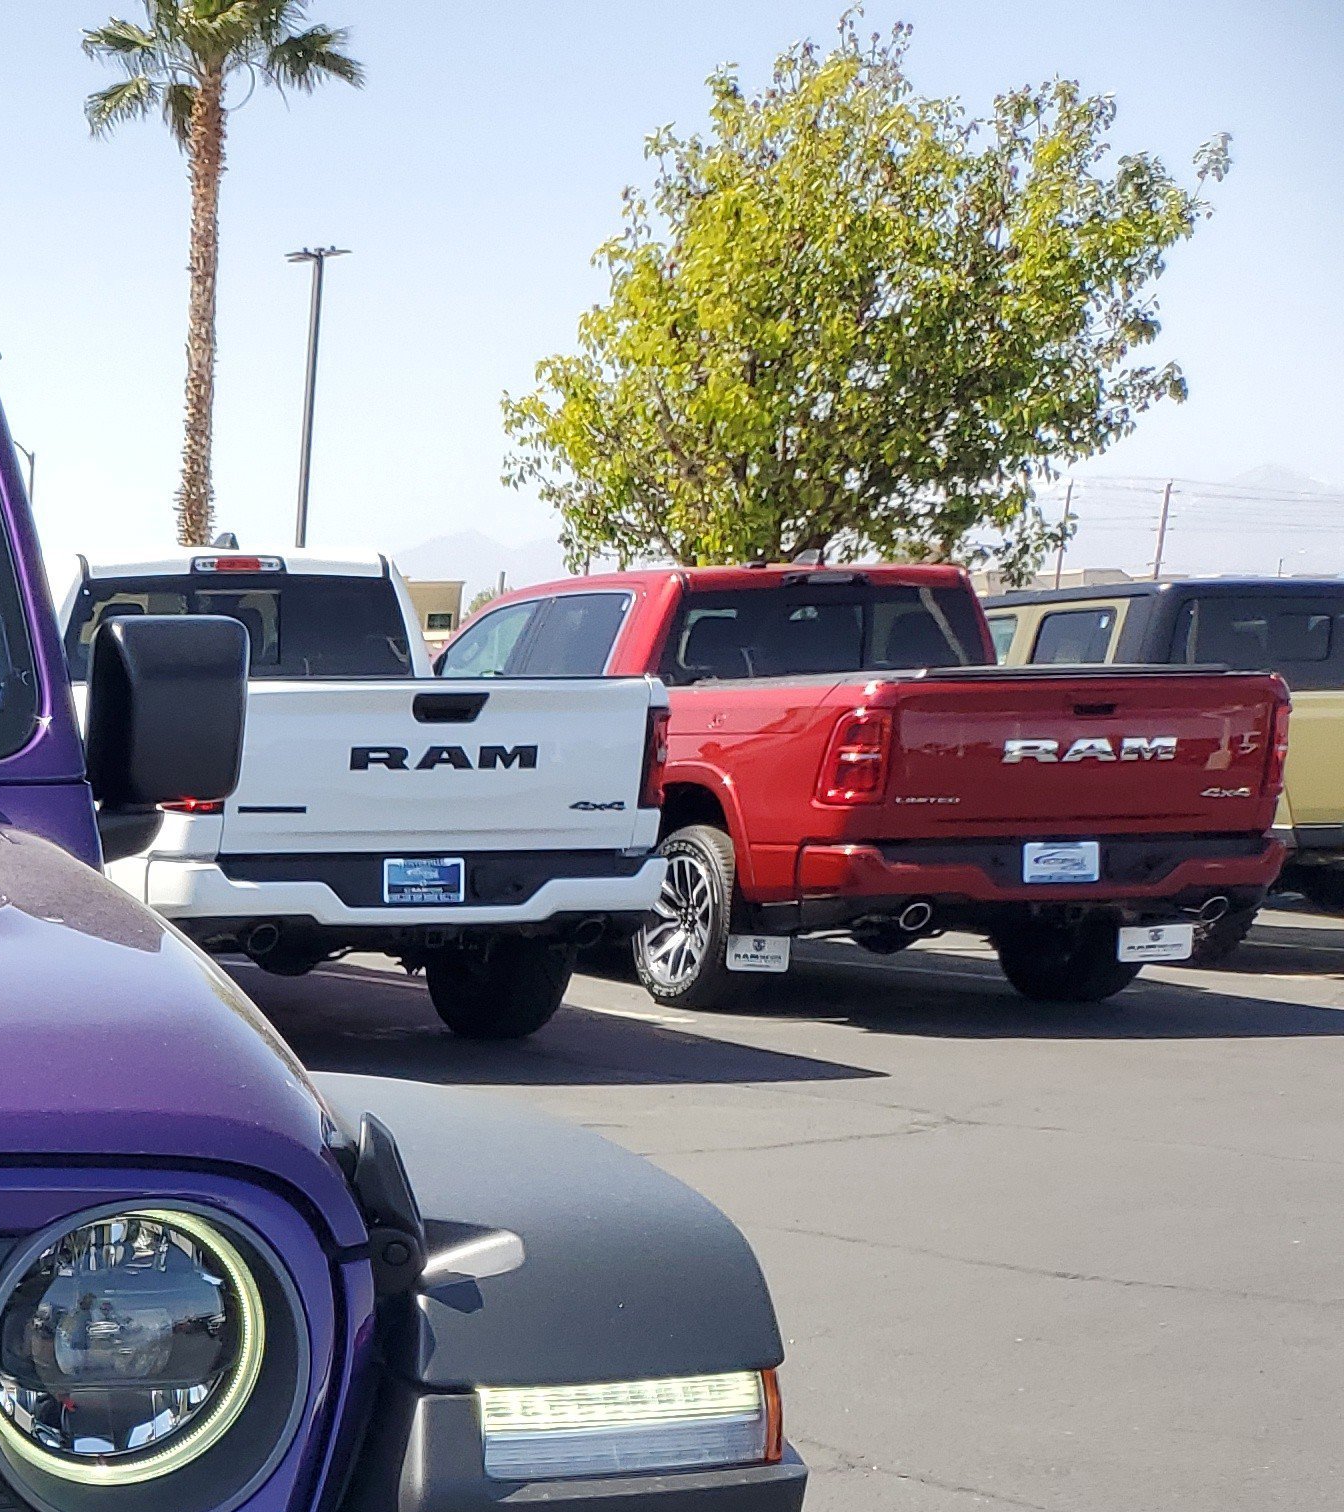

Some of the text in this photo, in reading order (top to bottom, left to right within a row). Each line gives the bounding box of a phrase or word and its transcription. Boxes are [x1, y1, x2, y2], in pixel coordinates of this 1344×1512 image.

[350, 745, 538, 770] RAM
[1002, 736, 1178, 764] RAM
[1200, 787, 1250, 798] 4x4
